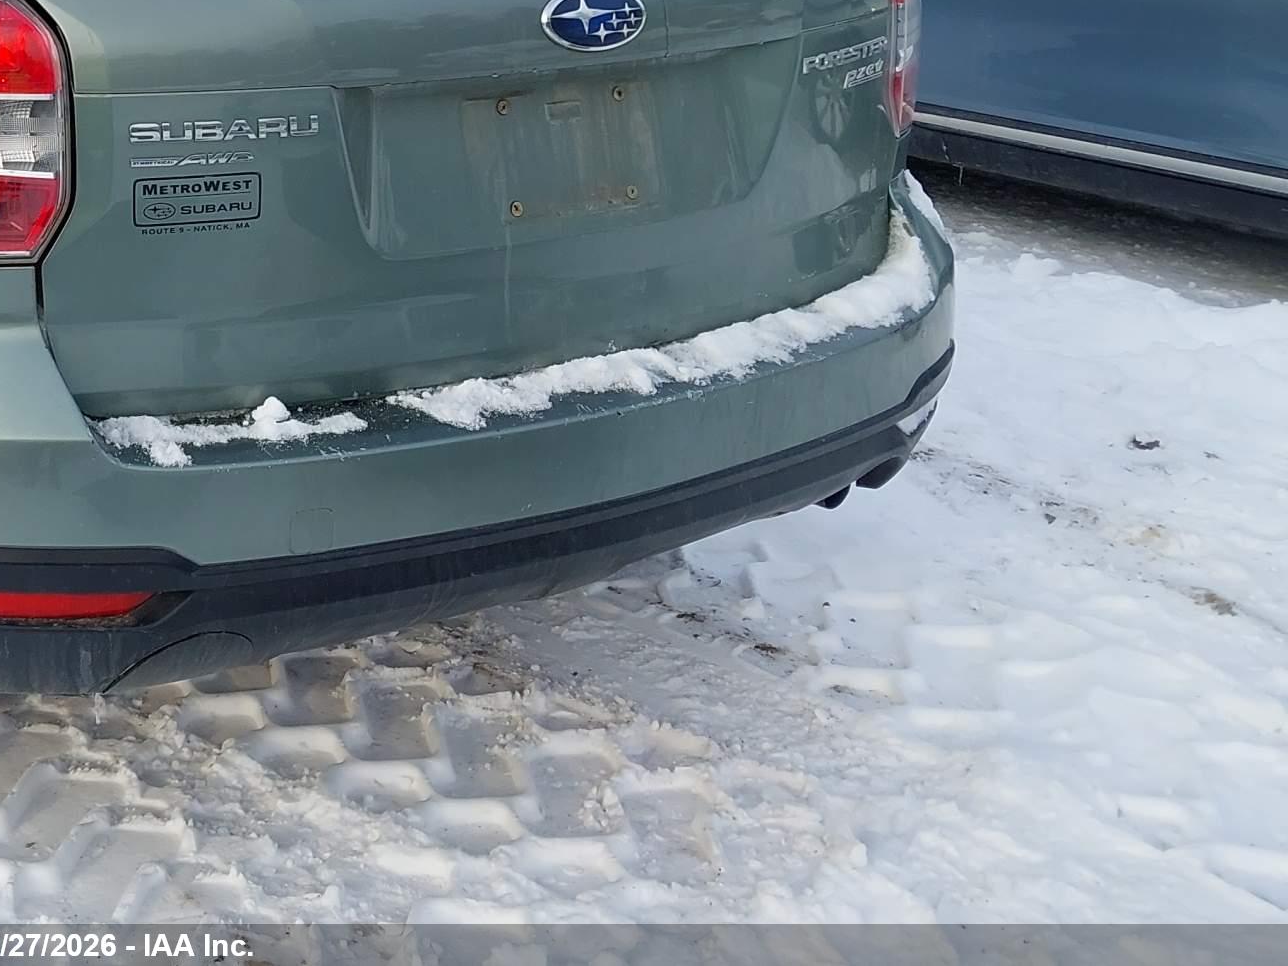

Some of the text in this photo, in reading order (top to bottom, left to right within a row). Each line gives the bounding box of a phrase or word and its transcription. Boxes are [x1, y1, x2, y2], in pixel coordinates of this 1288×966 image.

[802, 35, 888, 74] FORESTER
[129, 114, 319, 143] SUBARU
[177, 151, 254, 167] AWD
[180, 201, 253, 215] SUBARU
[141, 227, 176, 235] ROUTE
[193, 223, 233, 234] NATICK,
[235, 222, 251, 230] MA
